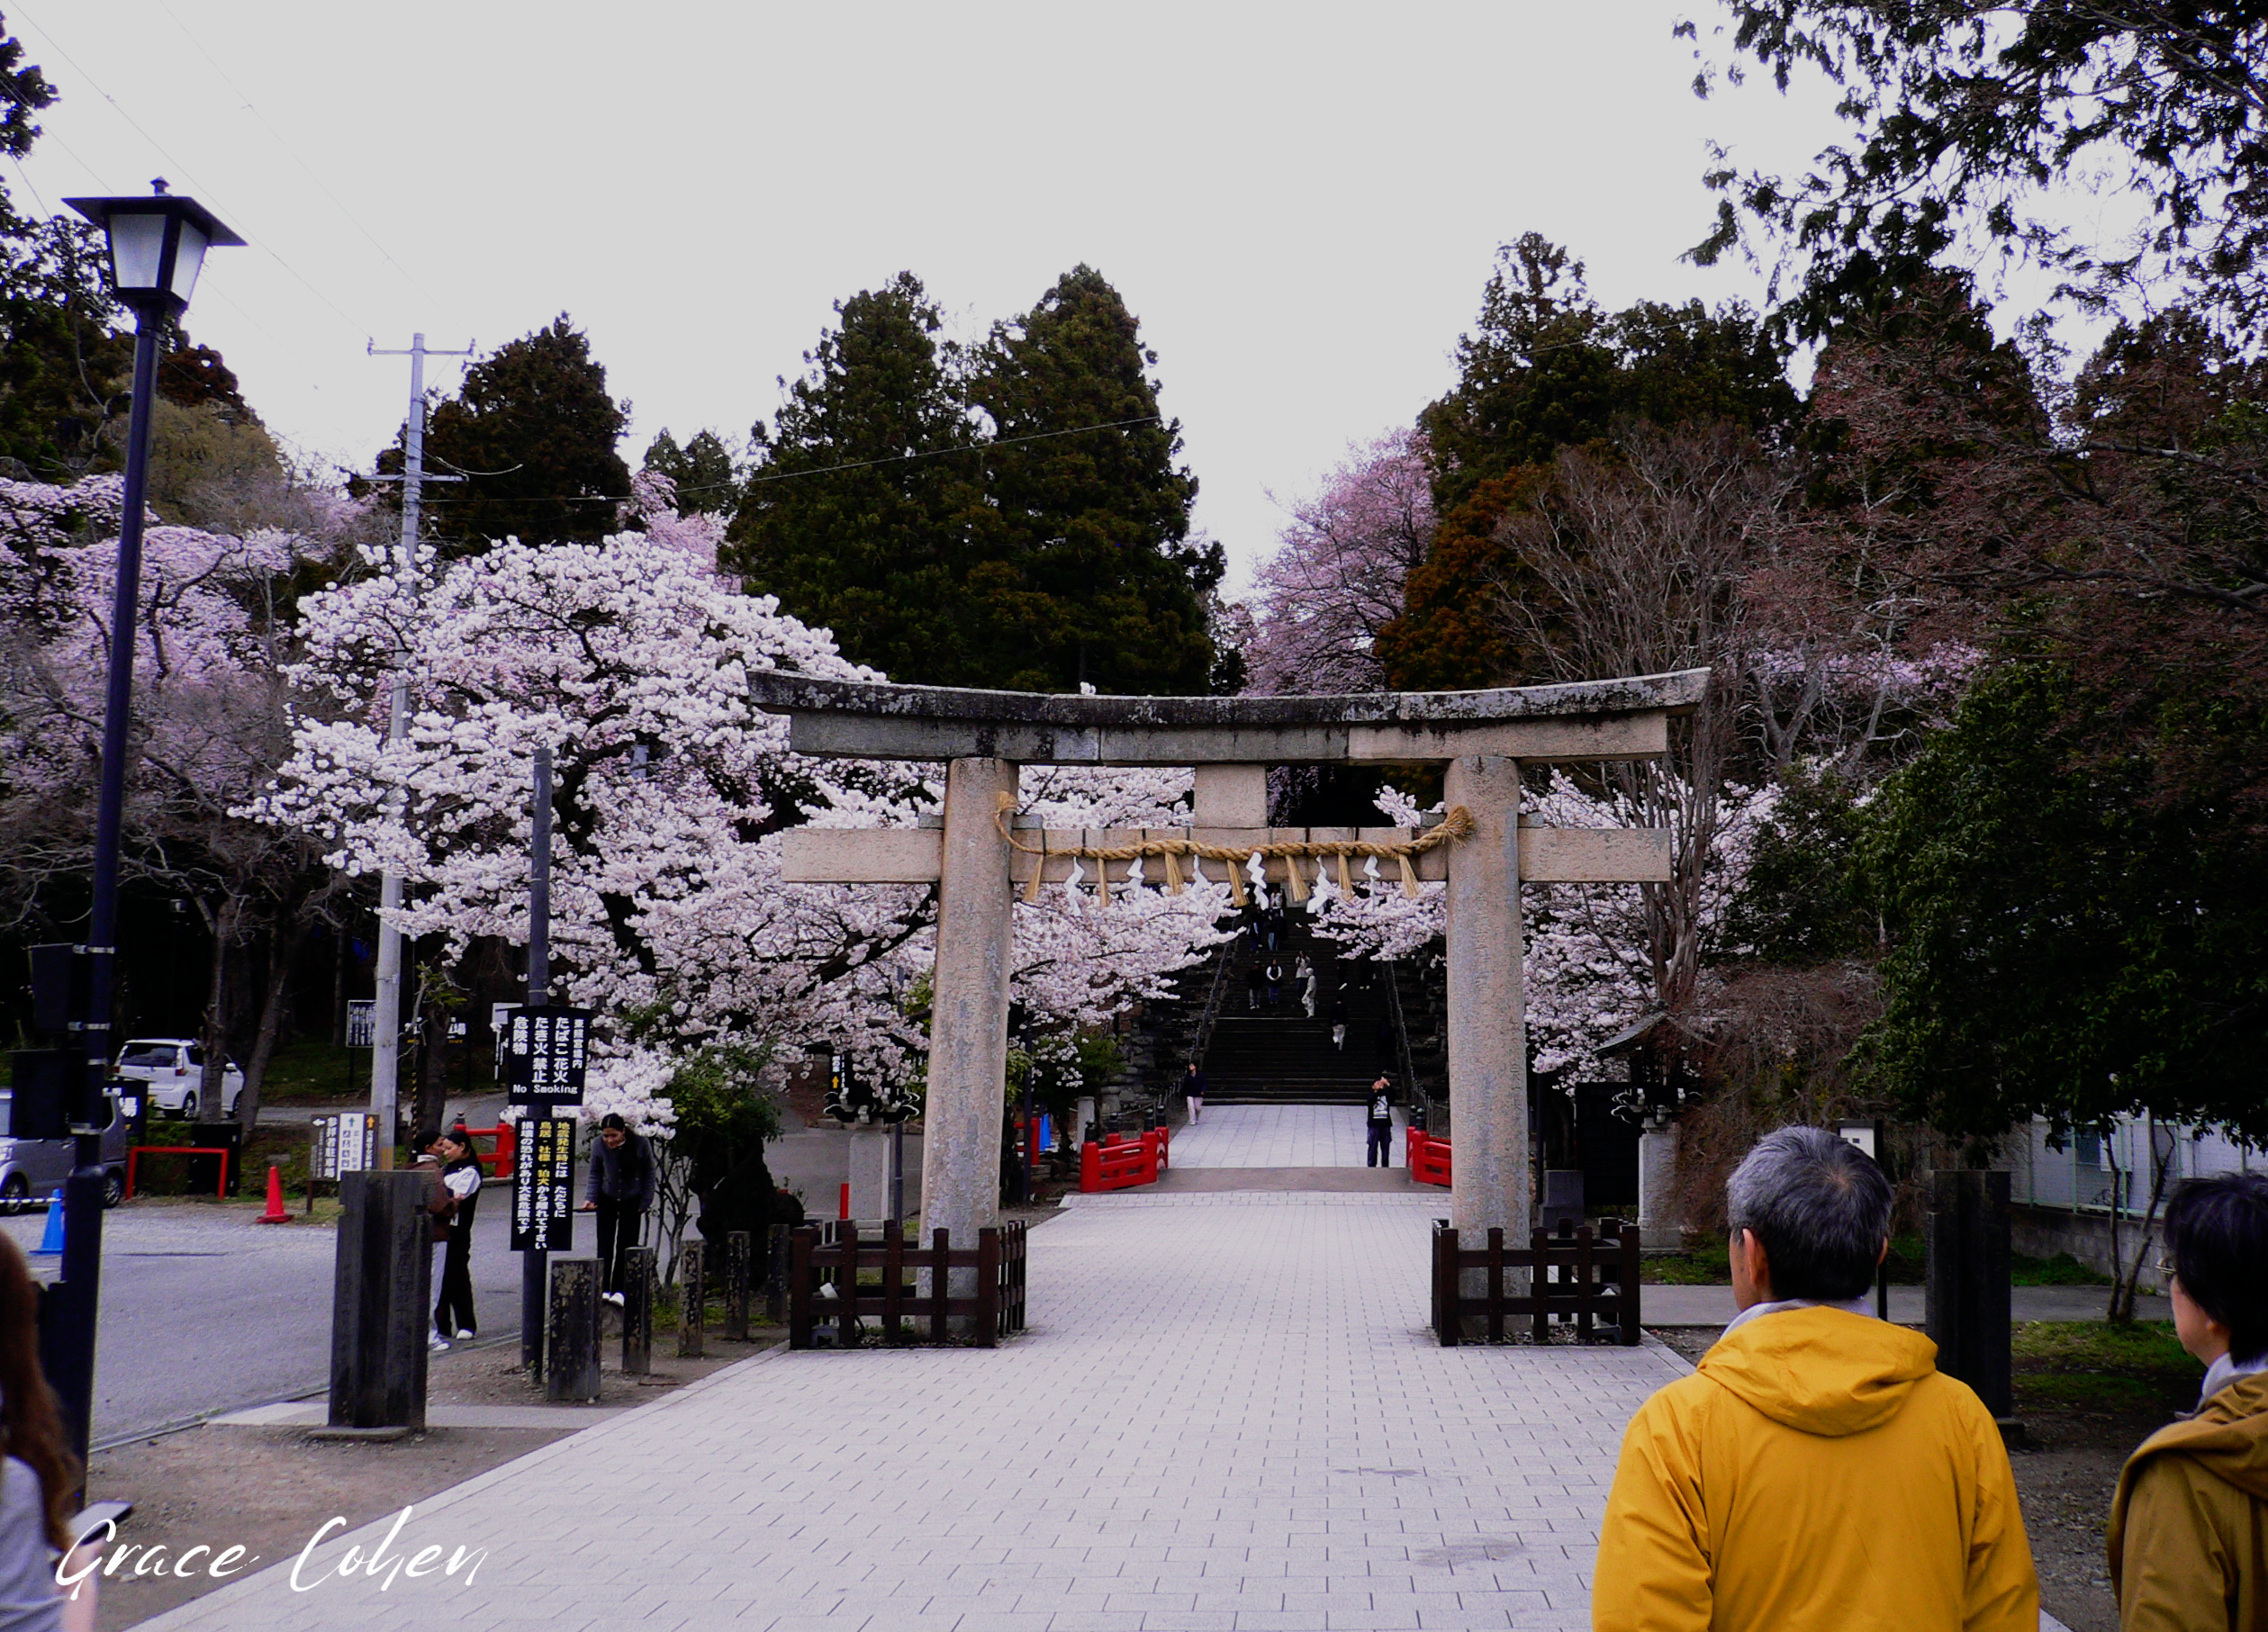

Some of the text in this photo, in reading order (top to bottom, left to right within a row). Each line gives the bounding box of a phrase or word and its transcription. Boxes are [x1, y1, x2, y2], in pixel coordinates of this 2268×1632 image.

[512, 1015, 529, 1056] 危険物
[512, 1084, 579, 1095] No Smoking
